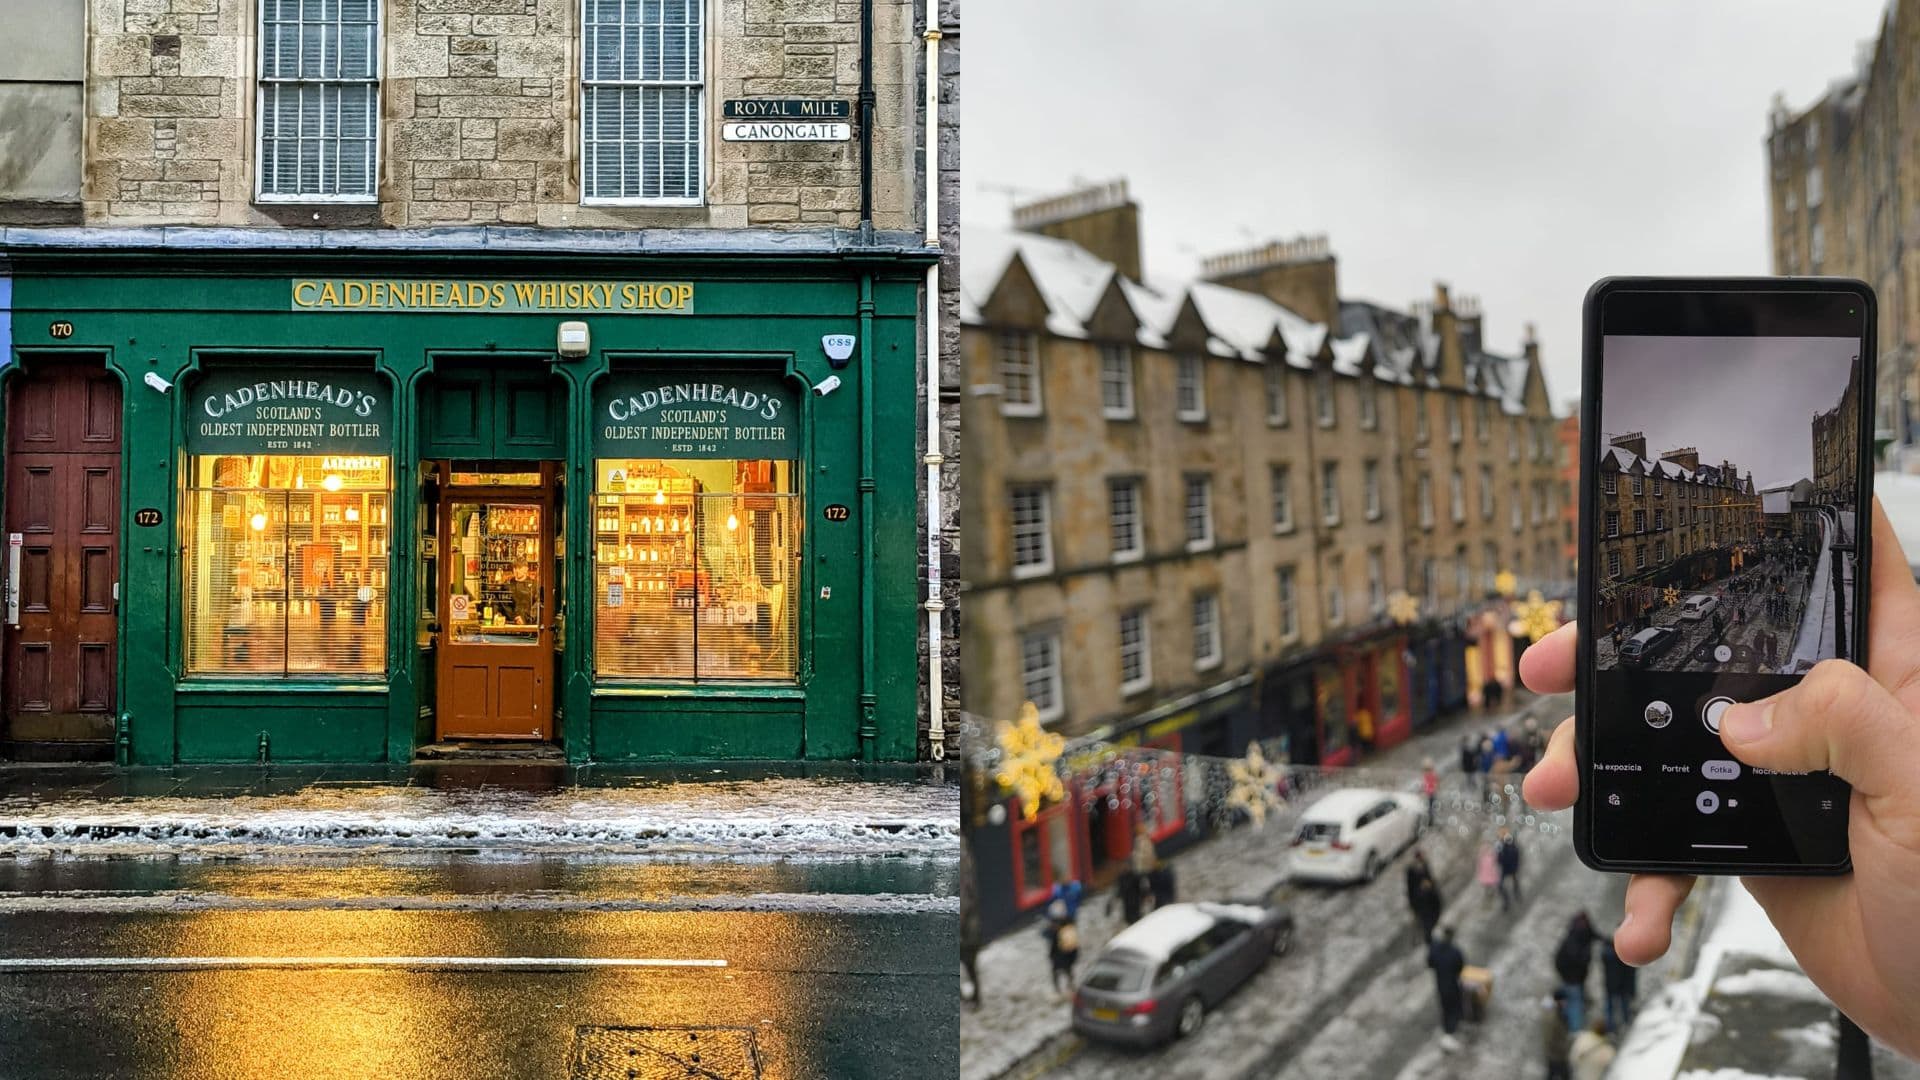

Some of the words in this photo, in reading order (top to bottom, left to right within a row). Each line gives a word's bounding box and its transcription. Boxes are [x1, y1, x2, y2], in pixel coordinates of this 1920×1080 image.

[734, 101, 790, 115] ROYAL
[800, 101, 839, 115] MILE
[735, 124, 838, 139] CANONGATE
[292, 281, 506, 309] CADENHEADS
[512, 282, 615, 309] WHISKY
[620, 283, 692, 310] SHOP
[51, 323, 73, 336] 170
[204, 380, 378, 418] CADENHEAD'S
[608, 383, 782, 421] CADENHEAD'S
[256, 406, 322, 420] SCOTLAND'S
[660, 410, 727, 423] SCOTLAND'S
[200, 423, 243, 436] OLDEST
[247, 423, 324, 437] INDEPENDENT
[330, 424, 380, 437] BOTTLER
[605, 426, 648, 440] OLDEST
[651, 426, 729, 440] INDEPENDENT
[735, 427, 786, 440] BOTTLER
[138, 511, 158, 524] 172
[825, 507, 847, 519] 172
[1661, 764, 1690, 773] Portrét
[1710, 766, 1733, 774] Fotka
